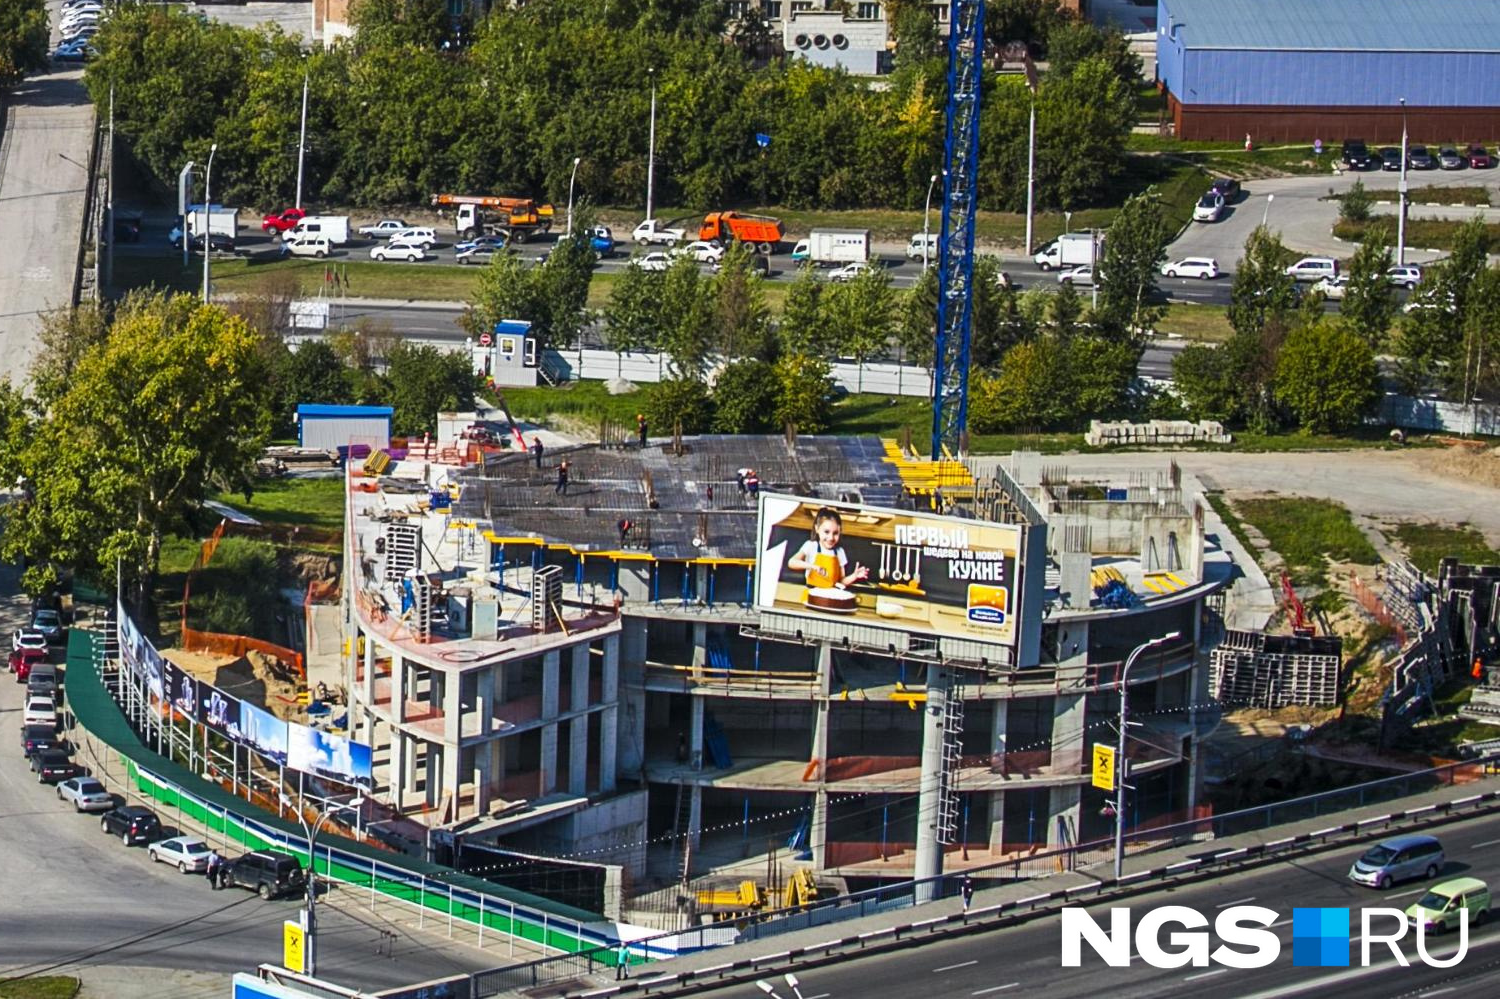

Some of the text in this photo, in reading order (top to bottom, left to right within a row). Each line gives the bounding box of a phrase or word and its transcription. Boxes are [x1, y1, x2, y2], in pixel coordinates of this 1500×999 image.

[895, 525, 969, 549] ПЕРВЫЙ
[923, 546, 1004, 561] шедевр на новой
[948, 559, 1004, 581] КУХНЕ
